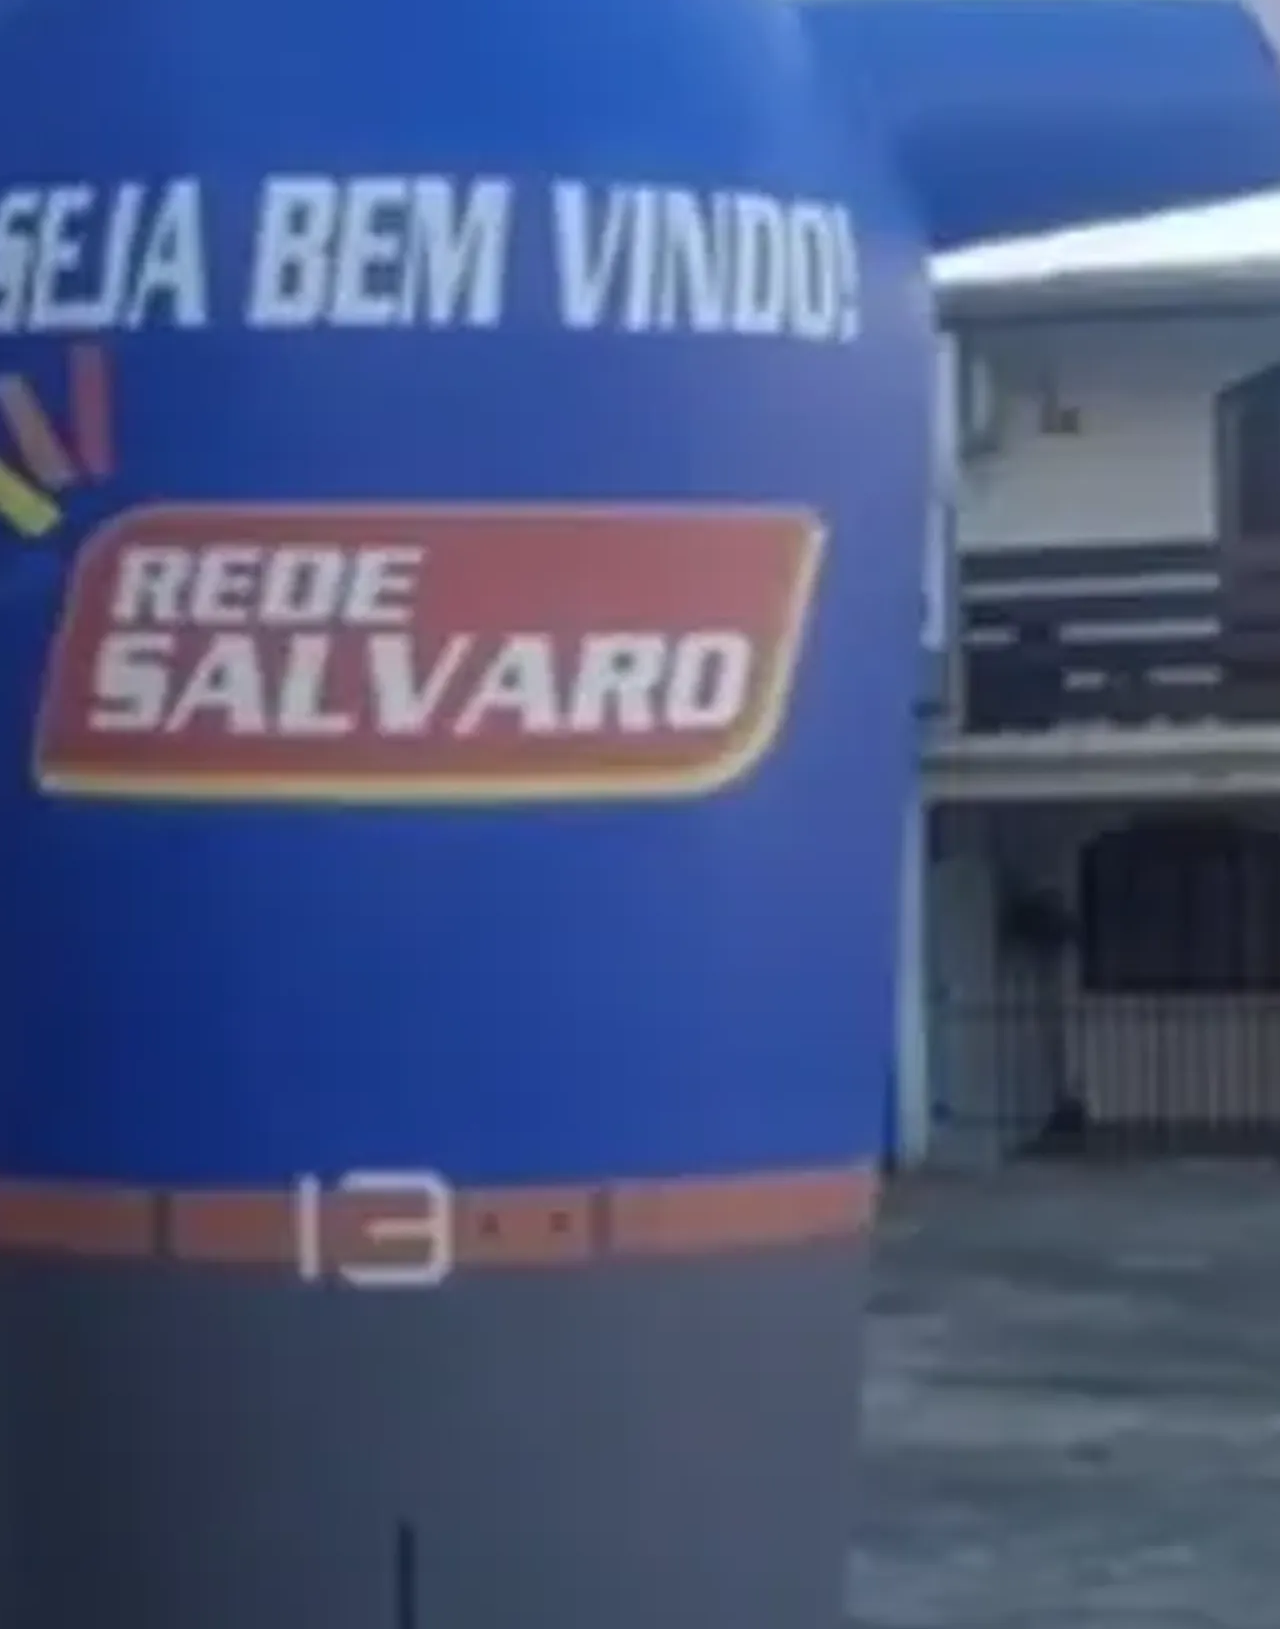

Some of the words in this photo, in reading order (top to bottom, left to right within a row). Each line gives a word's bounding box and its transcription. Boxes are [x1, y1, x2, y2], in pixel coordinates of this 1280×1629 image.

[247, 175, 511, 329] BEM
[552, 180, 859, 341] VINDO!
[110, 545, 426, 625] REDE
[88, 631, 751, 736] SALVARO
